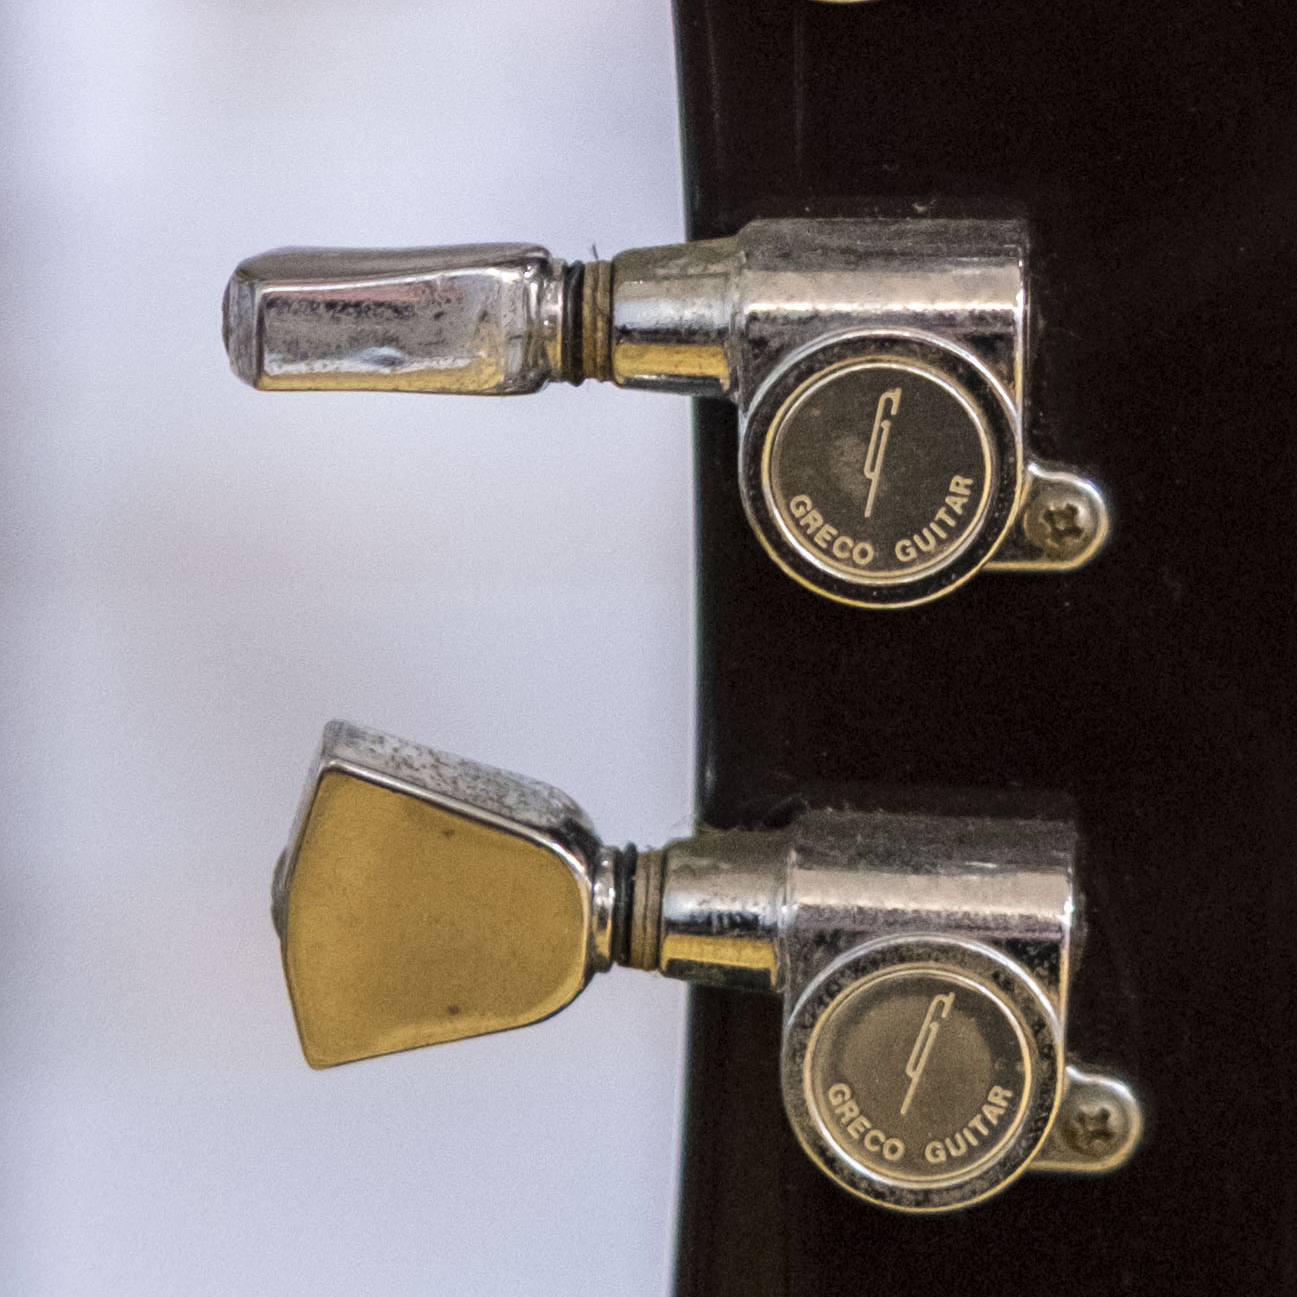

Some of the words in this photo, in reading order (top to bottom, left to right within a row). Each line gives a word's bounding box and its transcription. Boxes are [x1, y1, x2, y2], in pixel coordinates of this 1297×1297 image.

[789, 494, 874, 565] GRECO
[895, 474, 973, 562] GUITAR
[828, 1083, 905, 1161] GRECO
[925, 1085, 1013, 1163] GUITAR
